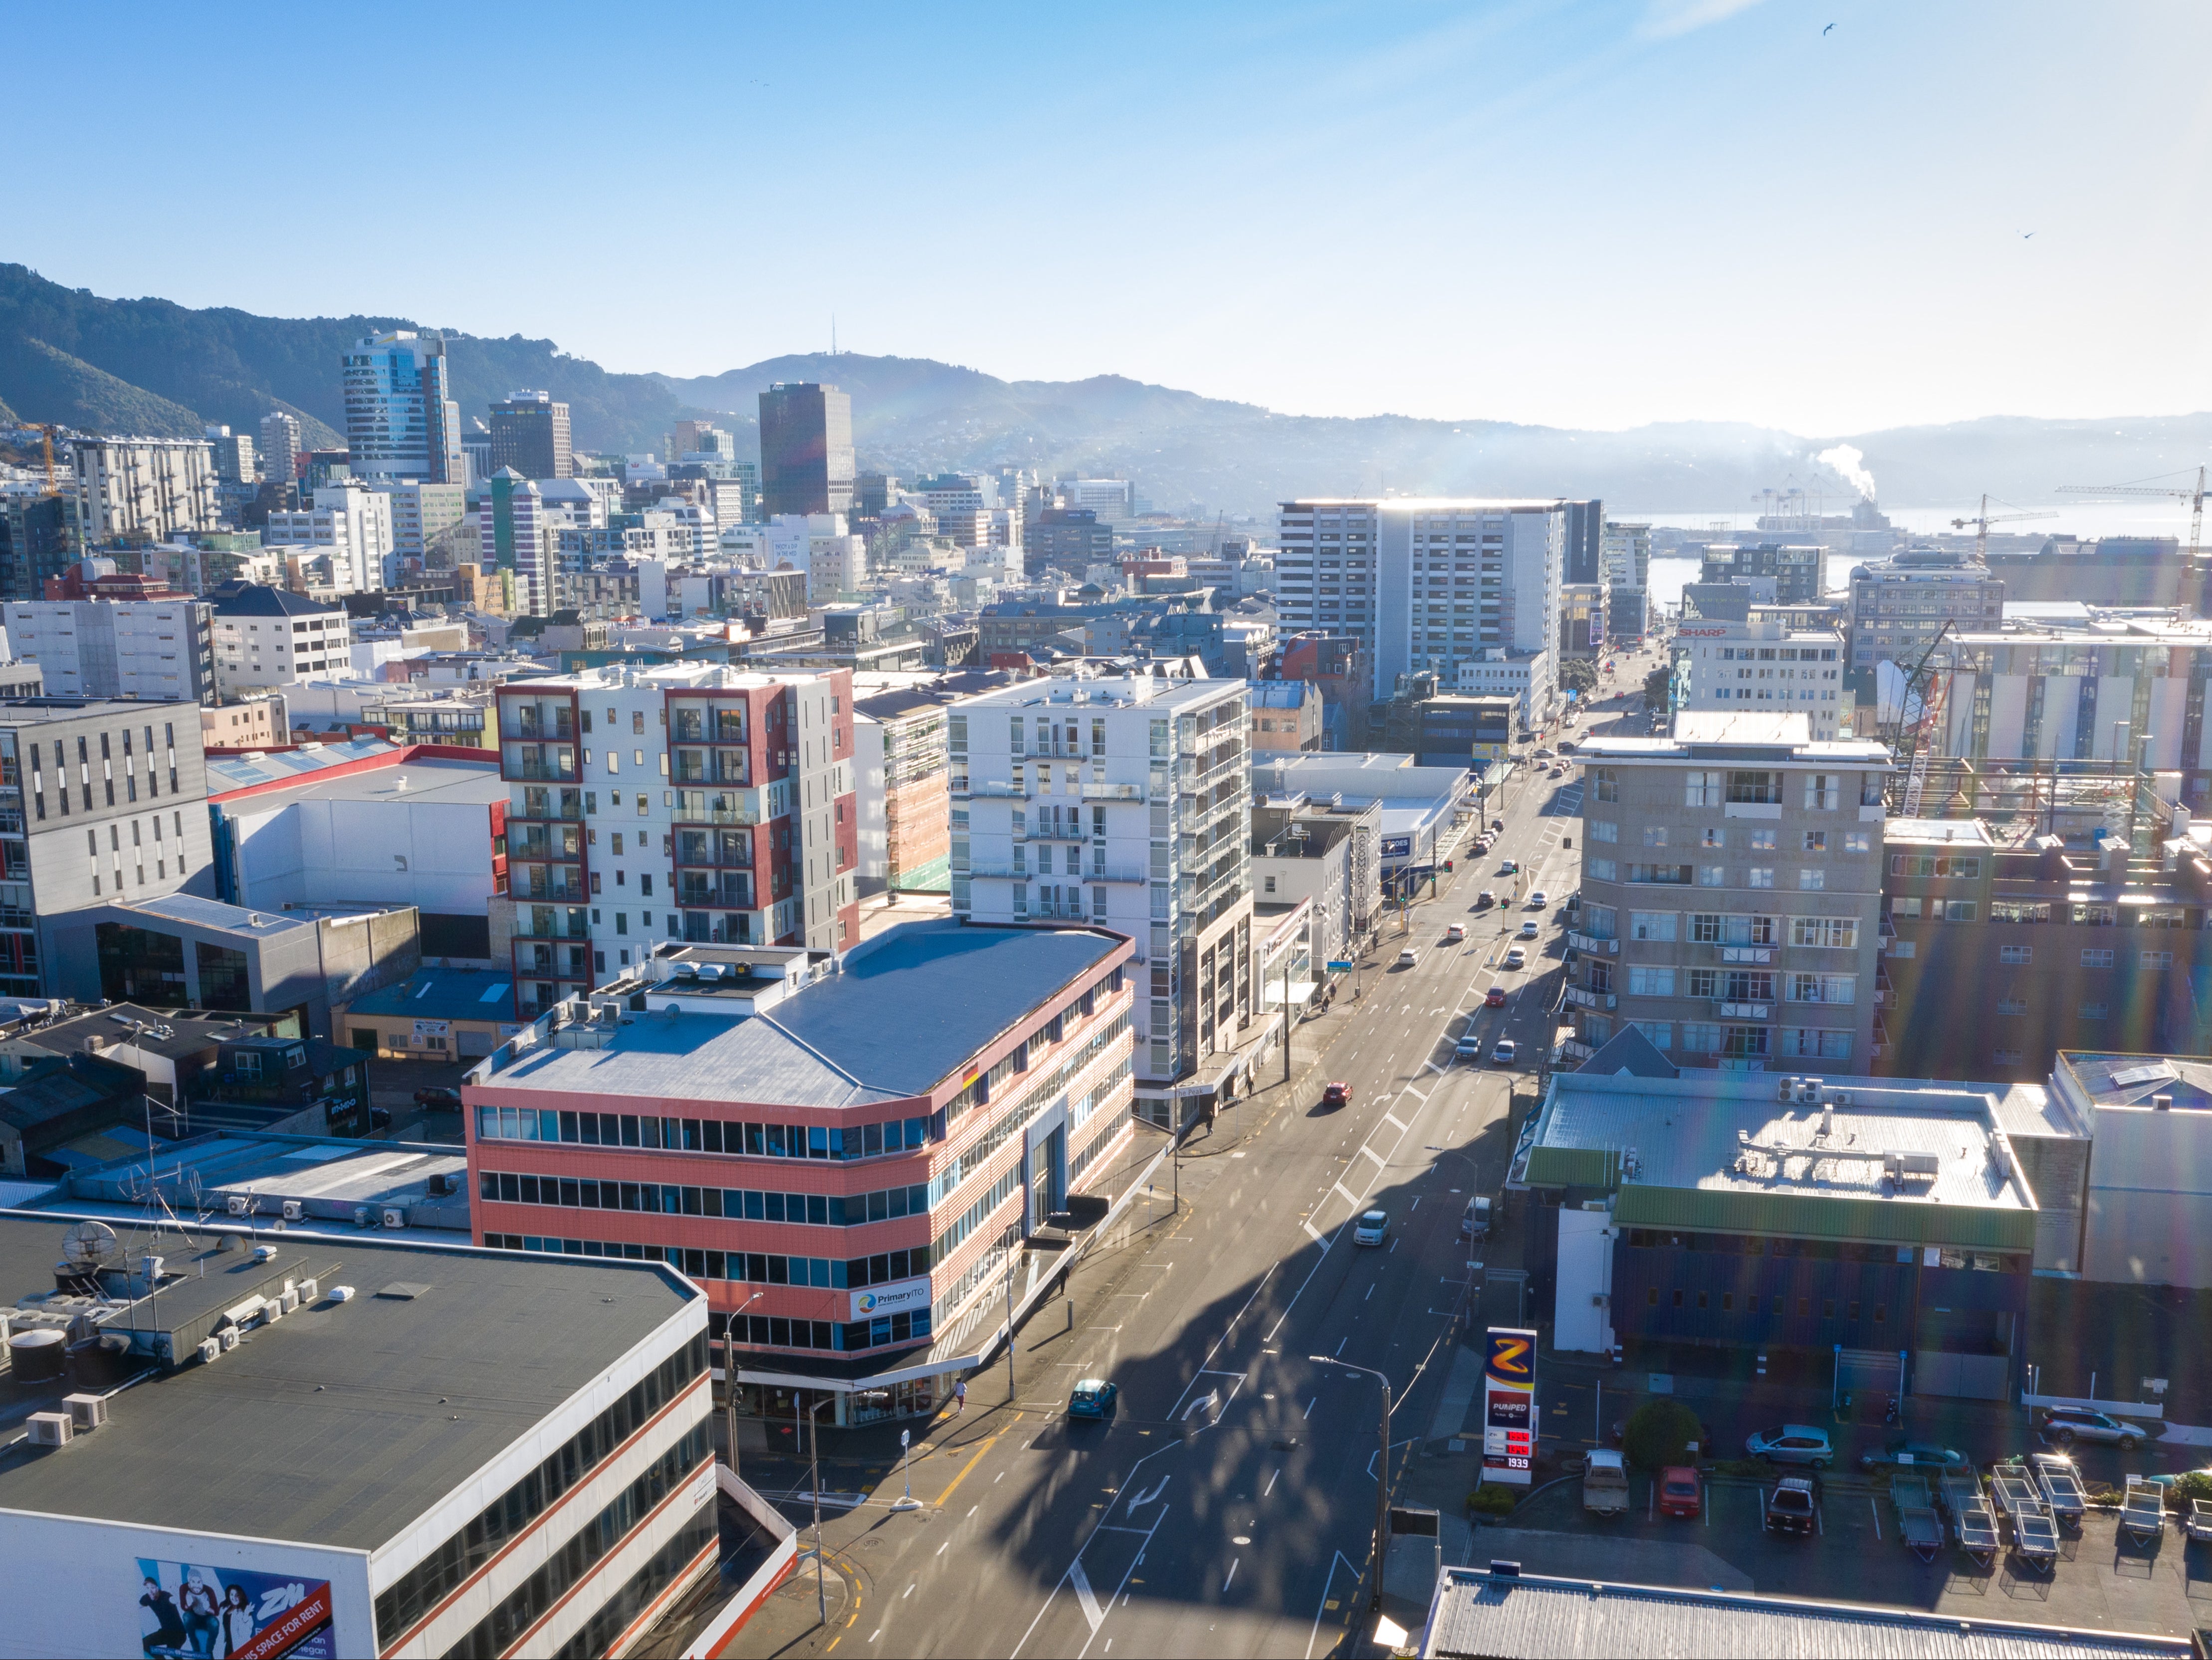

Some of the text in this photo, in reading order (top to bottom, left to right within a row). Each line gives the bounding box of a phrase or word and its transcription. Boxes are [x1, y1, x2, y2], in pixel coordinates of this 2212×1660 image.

[1357, 834, 1366, 908] ACCOMMODATION
[1493, 1403, 1527, 1412] PUMPED
[1508, 1458, 1528, 1468] 193.9
[256, 1583, 307, 1621] ZM
[256, 1631, 284, 1656] SPACE
[281, 1618, 302, 1636] FOR
[299, 1600, 324, 1623] RENT
